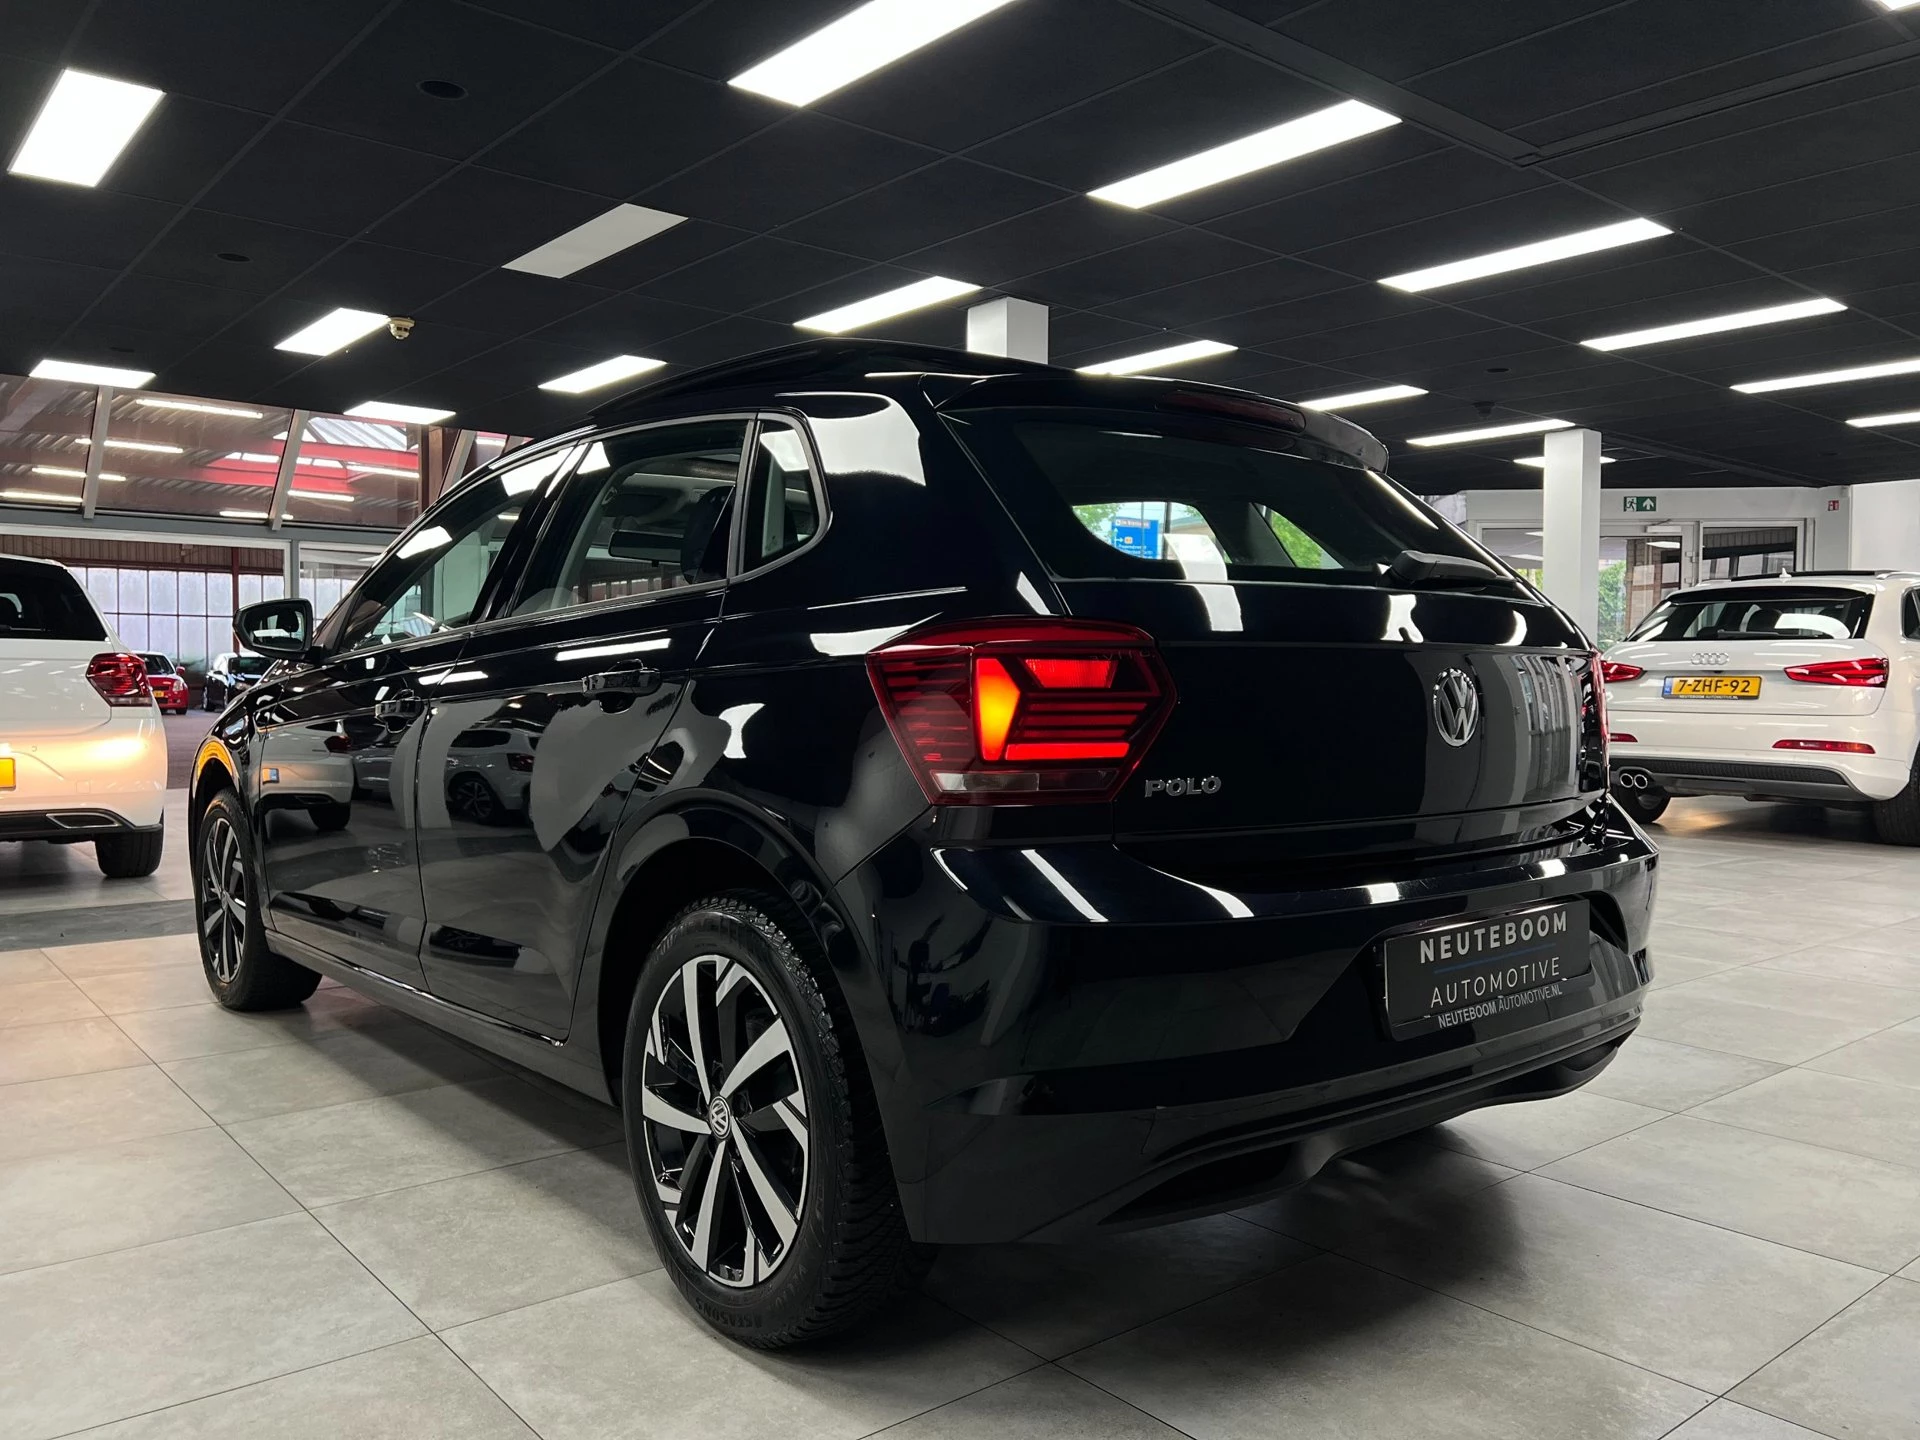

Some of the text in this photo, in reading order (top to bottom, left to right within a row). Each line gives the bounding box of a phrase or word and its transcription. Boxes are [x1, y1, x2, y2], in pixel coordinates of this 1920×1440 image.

[1678, 679, 1751, 693] 7-ZHF-92
[1144, 775, 1222, 798] POLO
[1420, 911, 1567, 964] NEUTEBOOM
[1430, 956, 1560, 1009] AUTOMOTIVE
[1437, 983, 1563, 1029] NEUTEBOOM AUTOMOTIVE.NL
